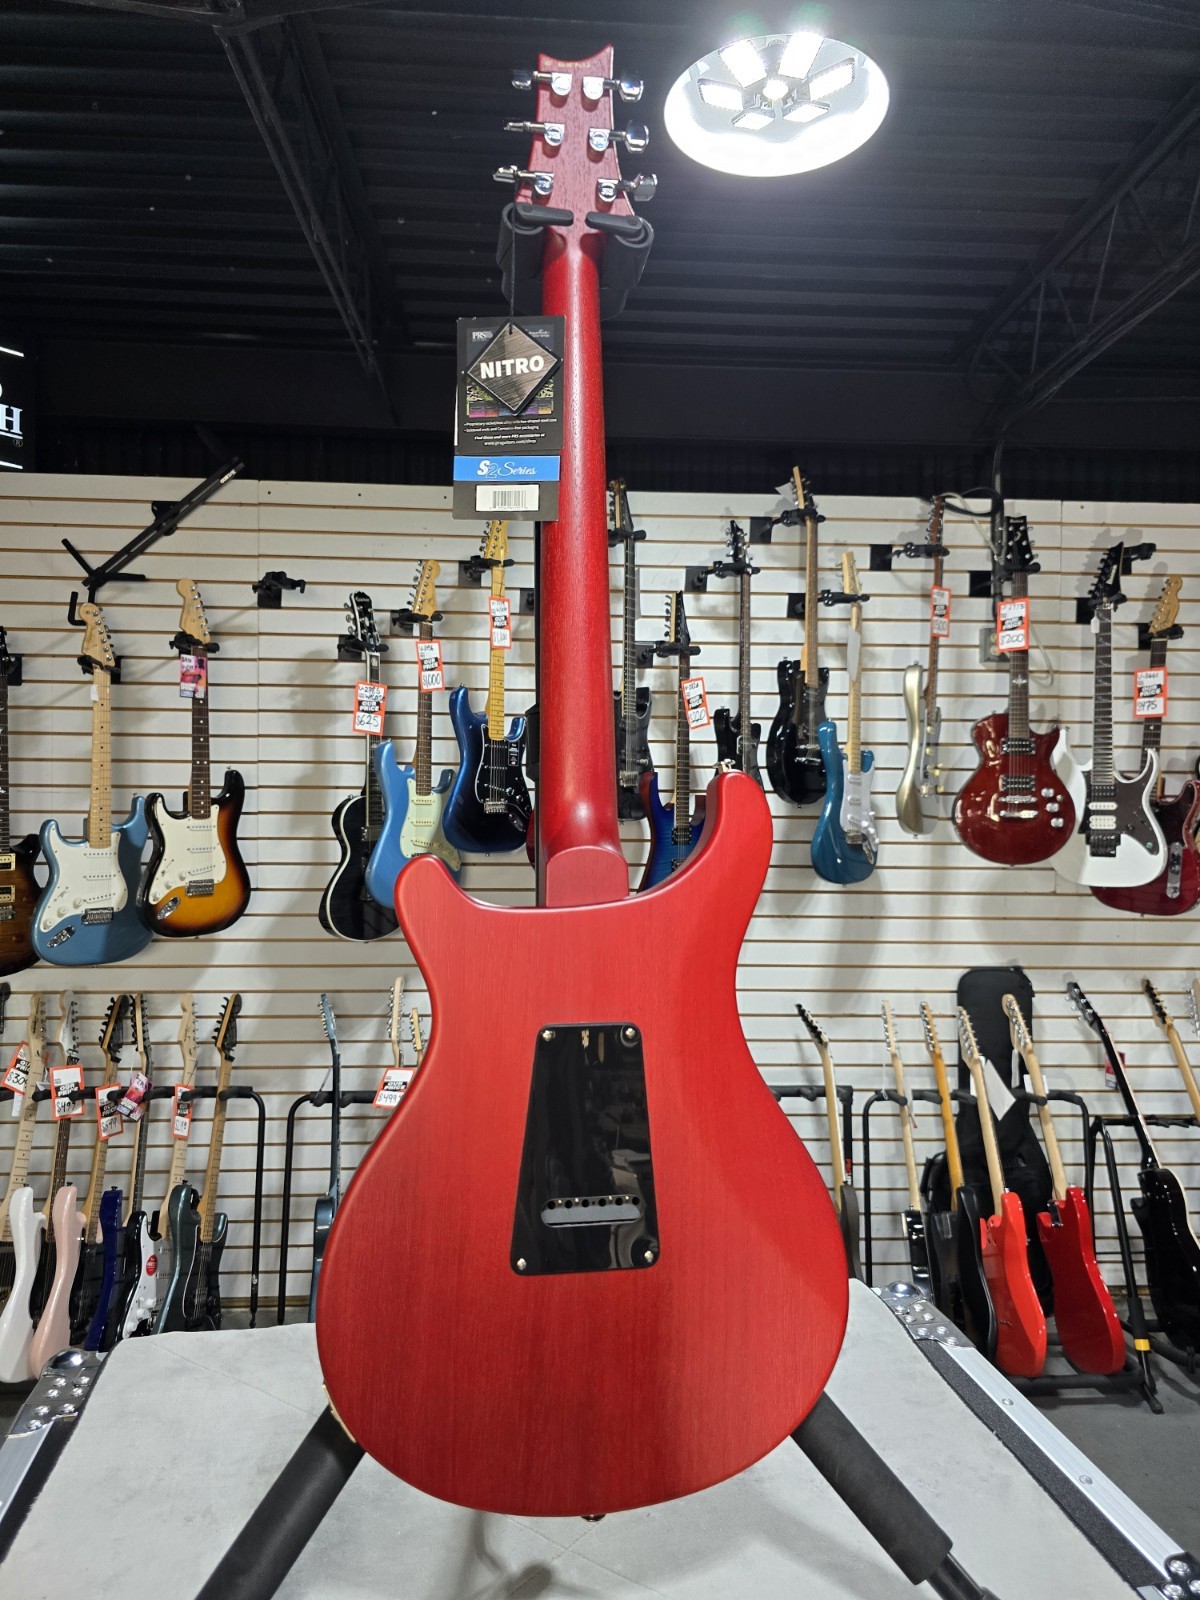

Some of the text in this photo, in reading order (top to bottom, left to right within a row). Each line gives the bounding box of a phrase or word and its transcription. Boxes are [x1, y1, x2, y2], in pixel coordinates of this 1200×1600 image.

[480, 355, 544, 379] NITRO
[477, 460, 537, 479] S2 Series
[1136, 700, 1158, 712] $475
[356, 714, 379, 727] $625
[20, 1060, 30, 1068] OU
